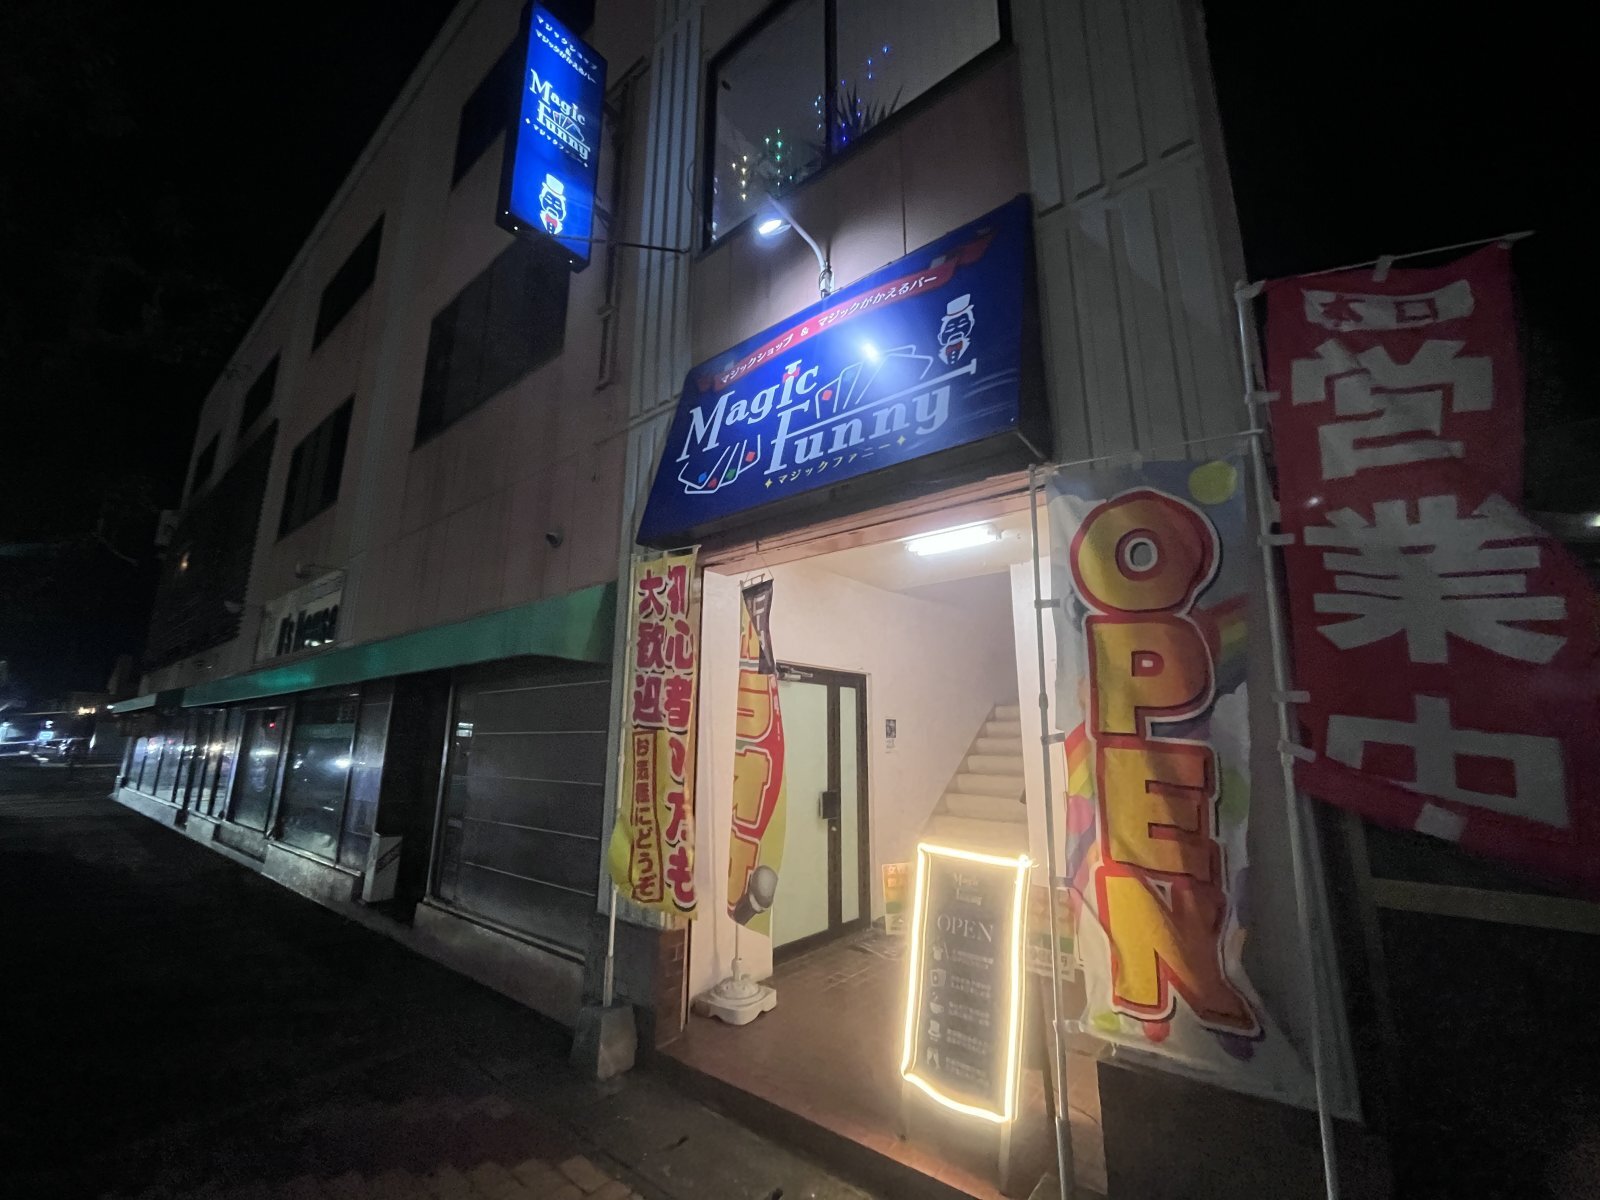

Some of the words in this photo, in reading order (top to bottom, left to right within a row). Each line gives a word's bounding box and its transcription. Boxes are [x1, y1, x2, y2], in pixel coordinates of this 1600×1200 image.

[529, 68, 586, 125] Magic
[536, 100, 591, 160] Funny
[721, 332, 794, 385] マジックショップ
[800, 326, 809, 337] &
[818, 276, 937, 328] マジックがかえるバー
[676, 359, 820, 463] Magic
[764, 359, 977, 475] Funny
[778, 442, 891, 485] マジックファニー
[1291, 339, 1571, 842] 営業中
[1071, 487, 1262, 1034] OPEN
[937, 913, 994, 943] OPEN
